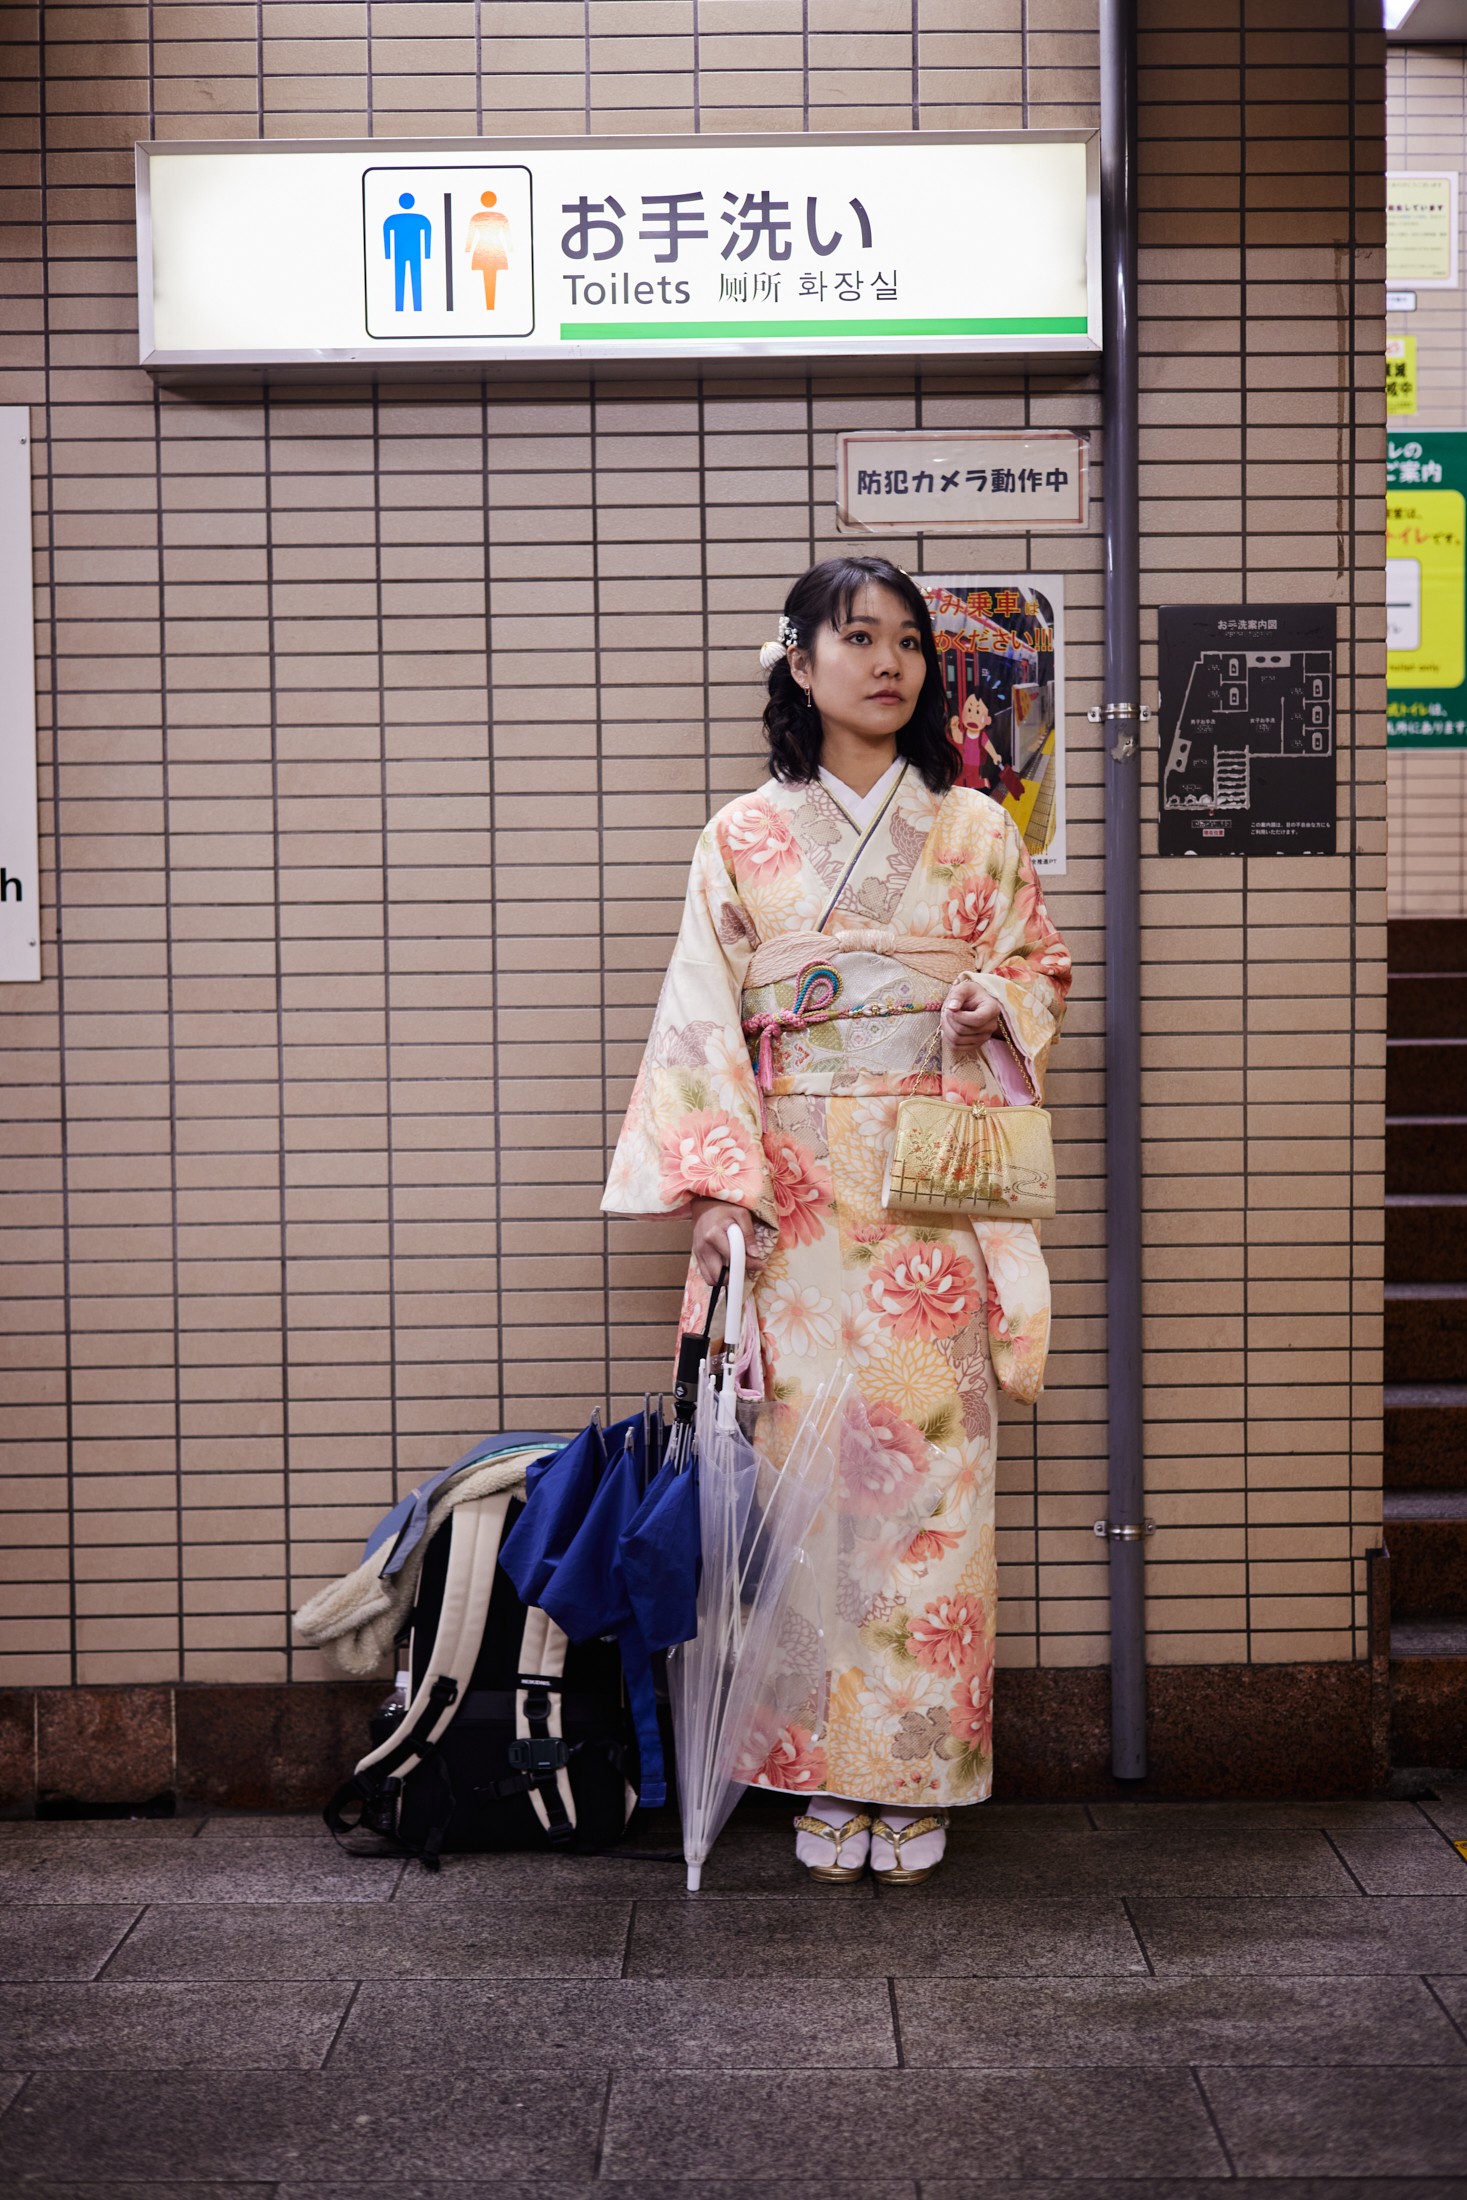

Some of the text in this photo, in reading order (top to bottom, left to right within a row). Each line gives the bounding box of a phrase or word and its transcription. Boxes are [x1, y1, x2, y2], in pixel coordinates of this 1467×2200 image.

[561, 190, 872, 263] お手洗い
[563, 269, 898, 305] Toilets 厕所 화장실
[1388, 441, 1423, 460] レの
[857, 468, 1069, 495] 防犯カメラ動作中
[1217, 619, 1278, 631] お手洗案内図
